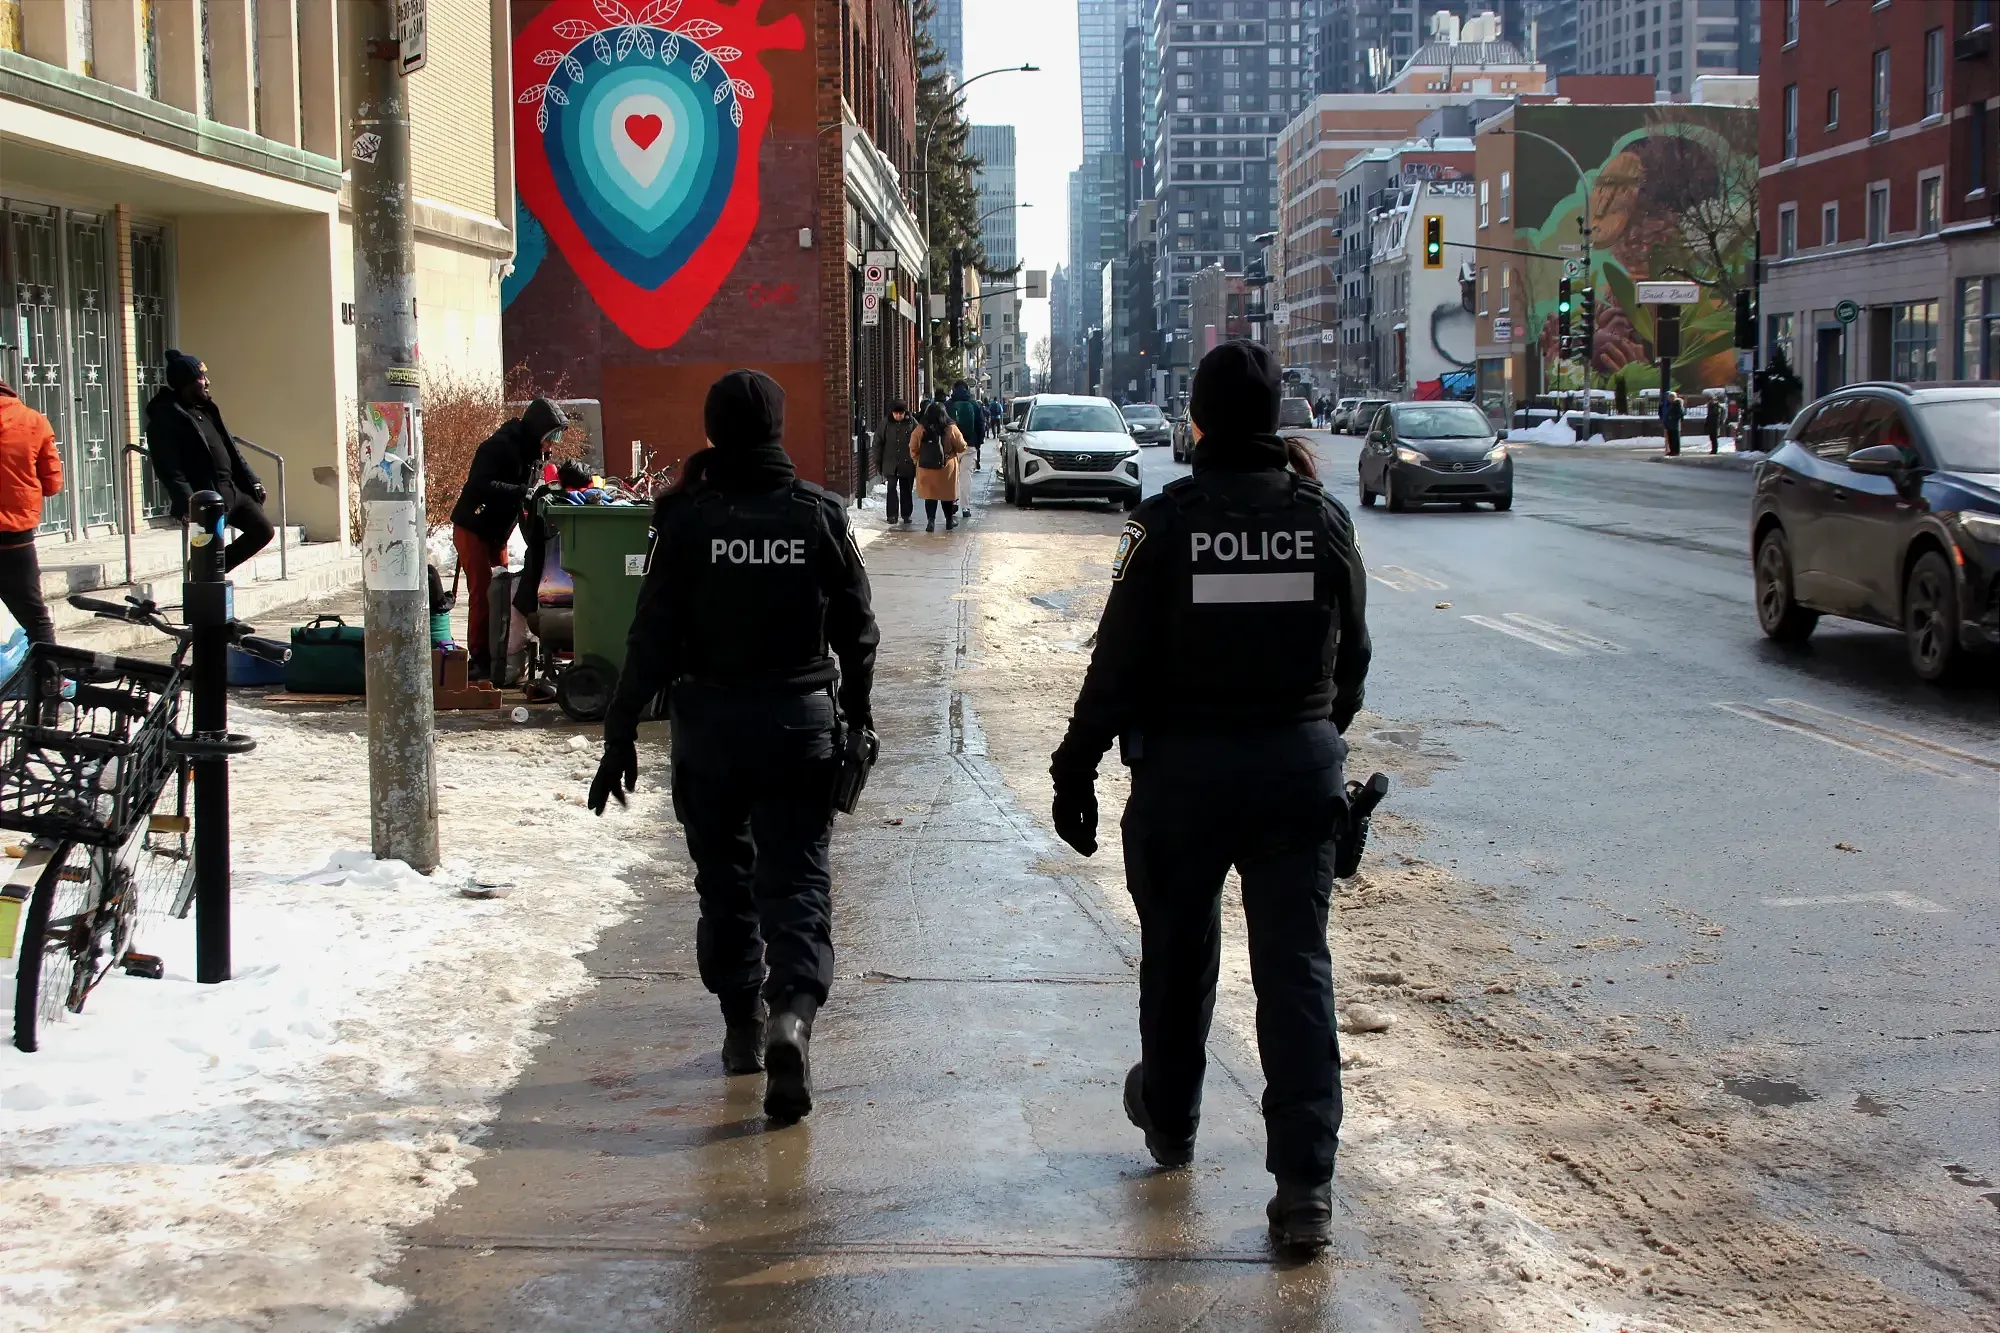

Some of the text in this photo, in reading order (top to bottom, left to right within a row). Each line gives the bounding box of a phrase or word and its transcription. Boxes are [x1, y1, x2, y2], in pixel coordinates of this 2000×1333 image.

[1323, 333, 1333, 342] 40
[711, 538, 806, 564] POLICE
[1191, 530, 1315, 562] POLICE
